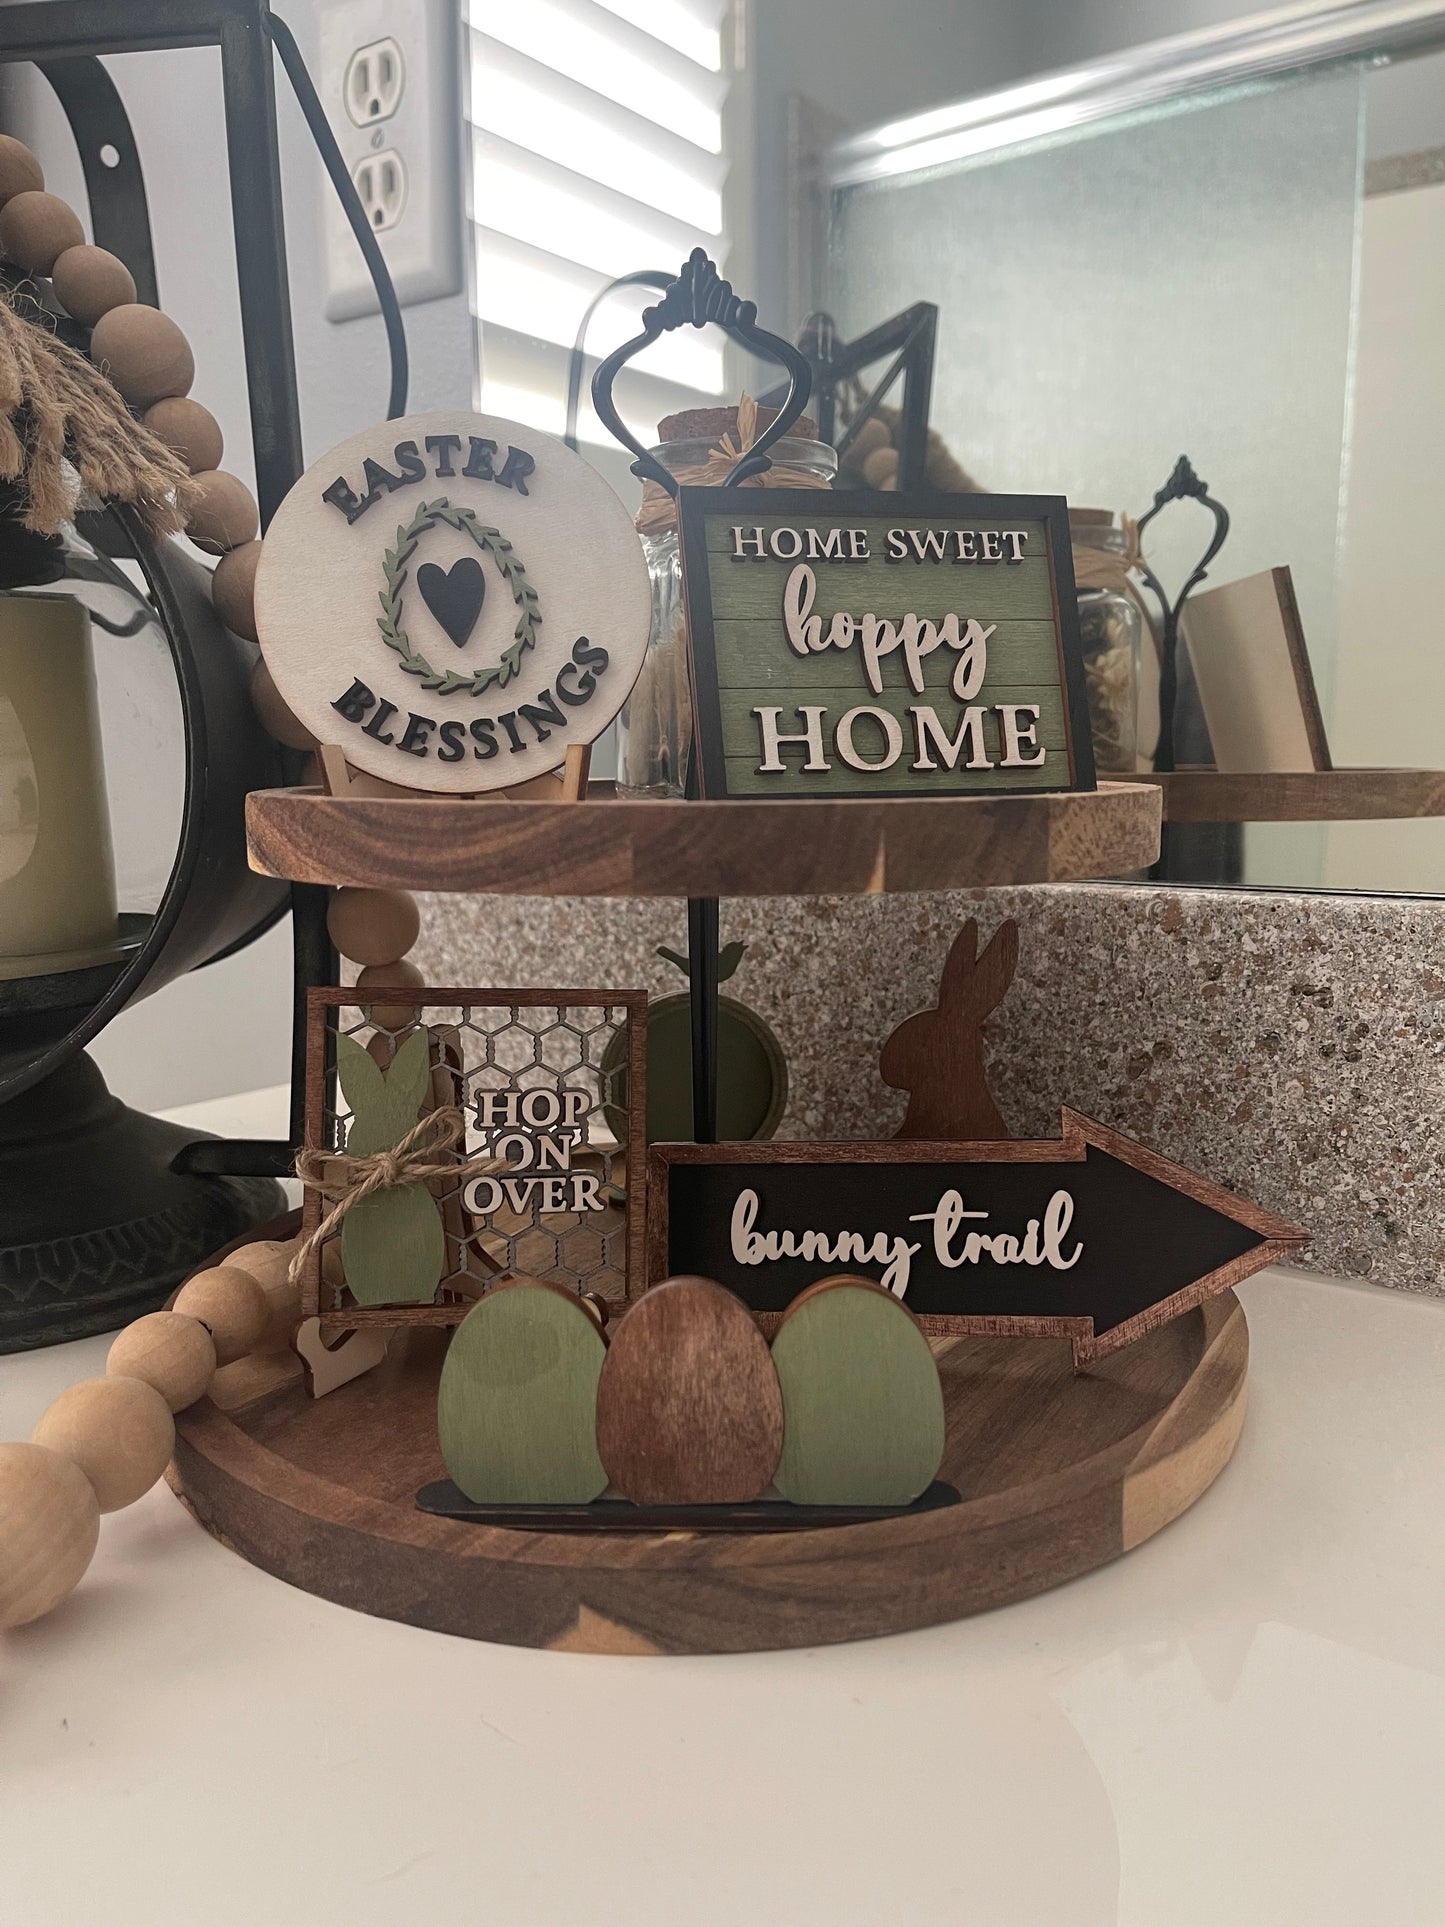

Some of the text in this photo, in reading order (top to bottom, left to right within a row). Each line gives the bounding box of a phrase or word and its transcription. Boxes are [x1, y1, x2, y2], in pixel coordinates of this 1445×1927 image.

[322, 434, 536, 525] EASTER
[731, 526, 1028, 562] HOME SWEET
[784, 563, 997, 700] hoppy
[330, 636, 609, 762] BLESSINGS
[752, 704, 1046, 772] HOME
[479, 1089, 590, 1127] HOP
[495, 1133, 573, 1172] ON
[464, 1175, 604, 1214] OVER
[731, 1188, 1083, 1300] bunny trail
